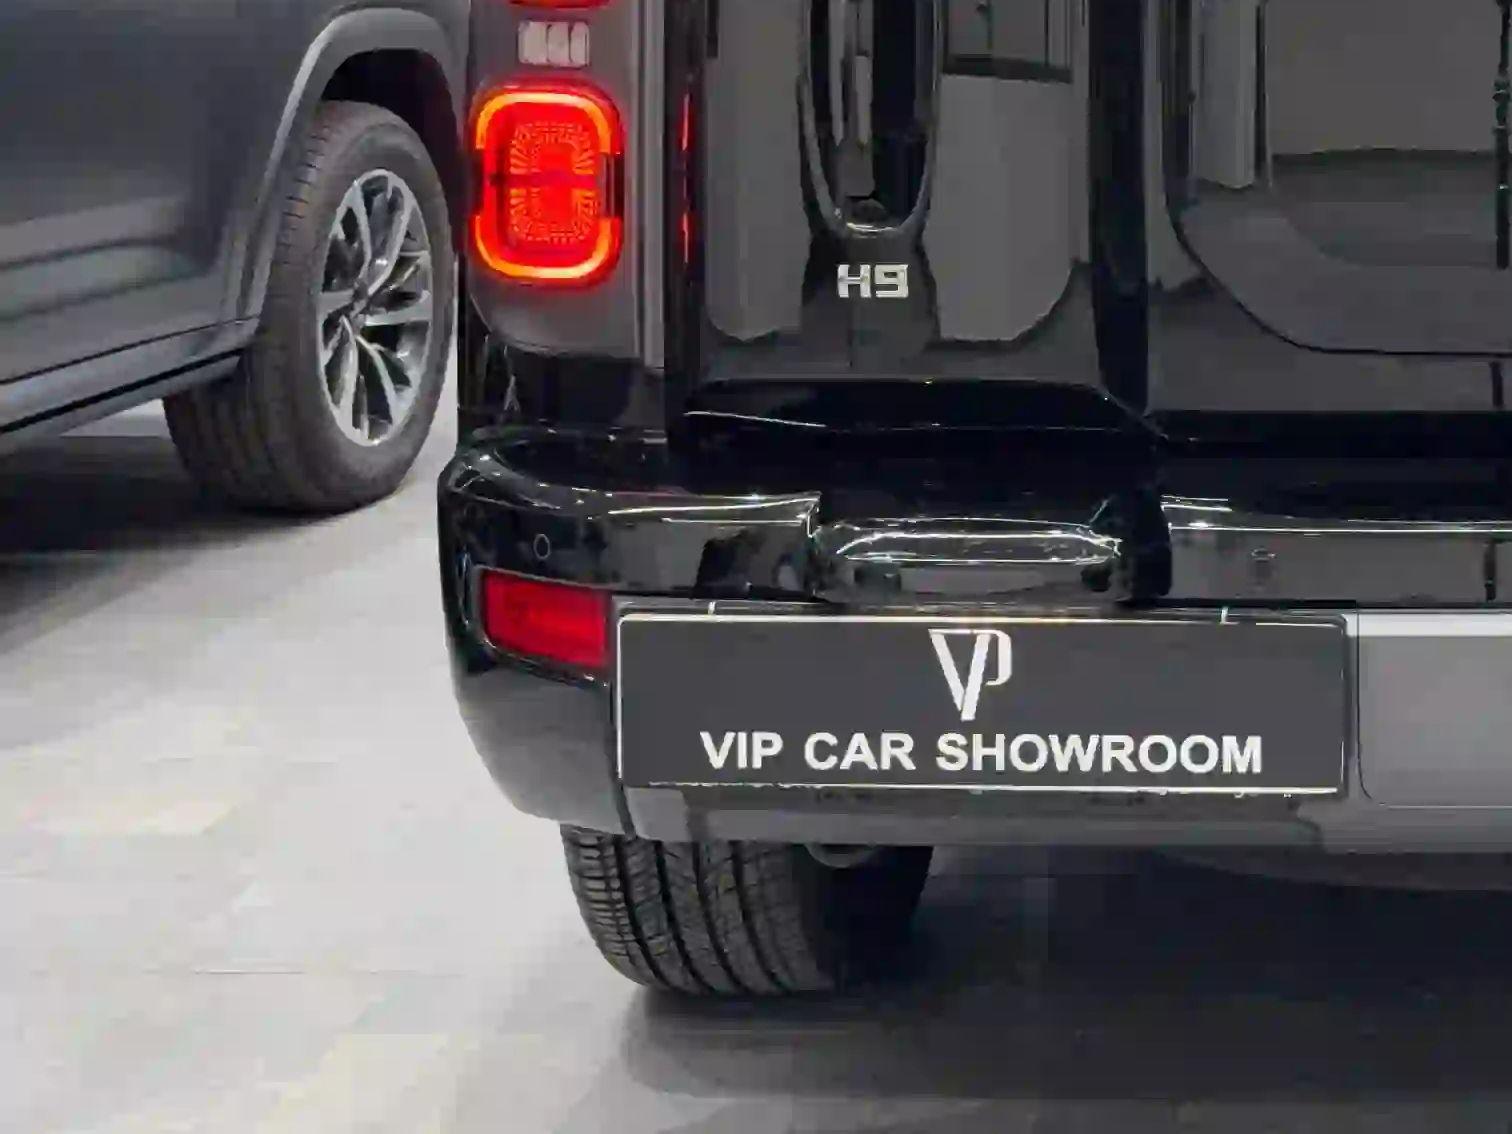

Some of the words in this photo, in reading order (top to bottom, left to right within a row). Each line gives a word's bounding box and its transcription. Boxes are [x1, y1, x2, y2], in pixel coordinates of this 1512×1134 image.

[837, 264, 909, 299] H9
[700, 731, 783, 769] VIP
[804, 732, 916, 771] CAR
[936, 733, 1263, 774] SHOWROOM
